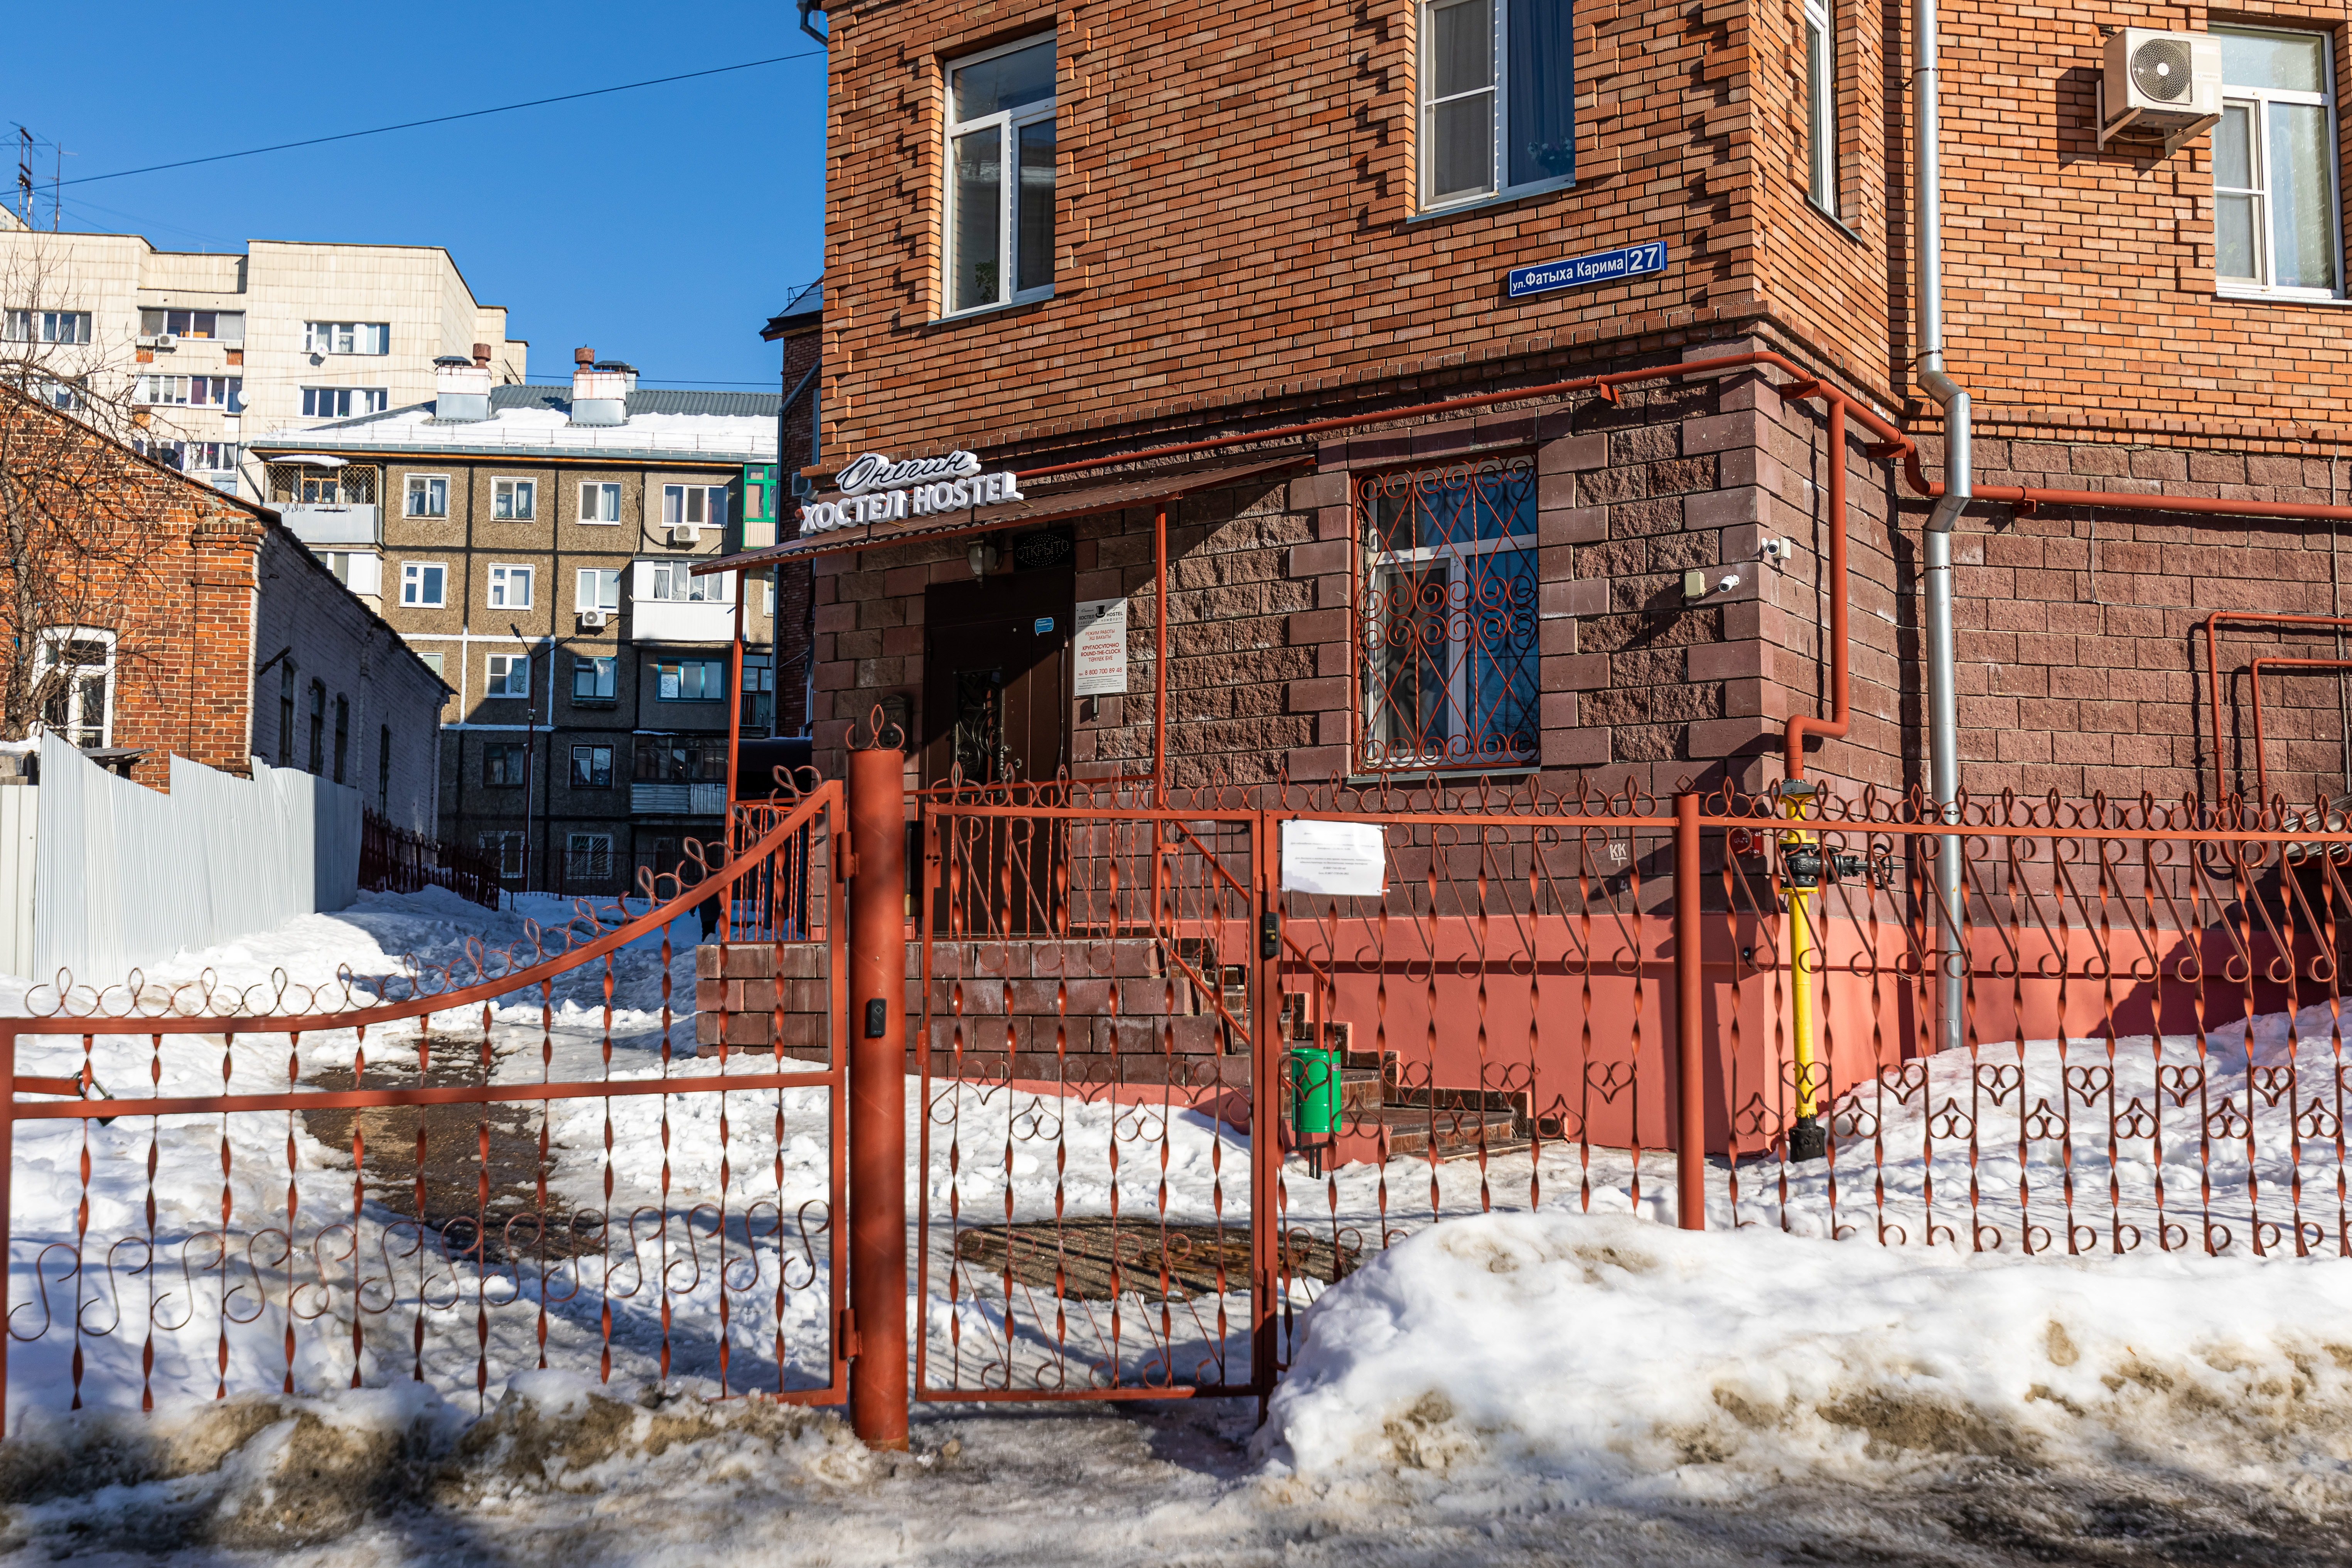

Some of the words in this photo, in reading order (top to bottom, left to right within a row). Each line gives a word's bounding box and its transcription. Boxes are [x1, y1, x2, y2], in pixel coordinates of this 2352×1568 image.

[1577, 258, 1624, 278] Карима
[1630, 247, 1658, 271] 27
[799, 490, 908, 534] ХОСТЕЛ
[913, 471, 1023, 515] HOSTEL
[1016, 540, 1069, 559] ОТКРЫТО
[1081, 649, 1121, 657] ROUND-THE-CLOCK
[1082, 642, 1119, 651] КРУГЛОСУТОЧНО
